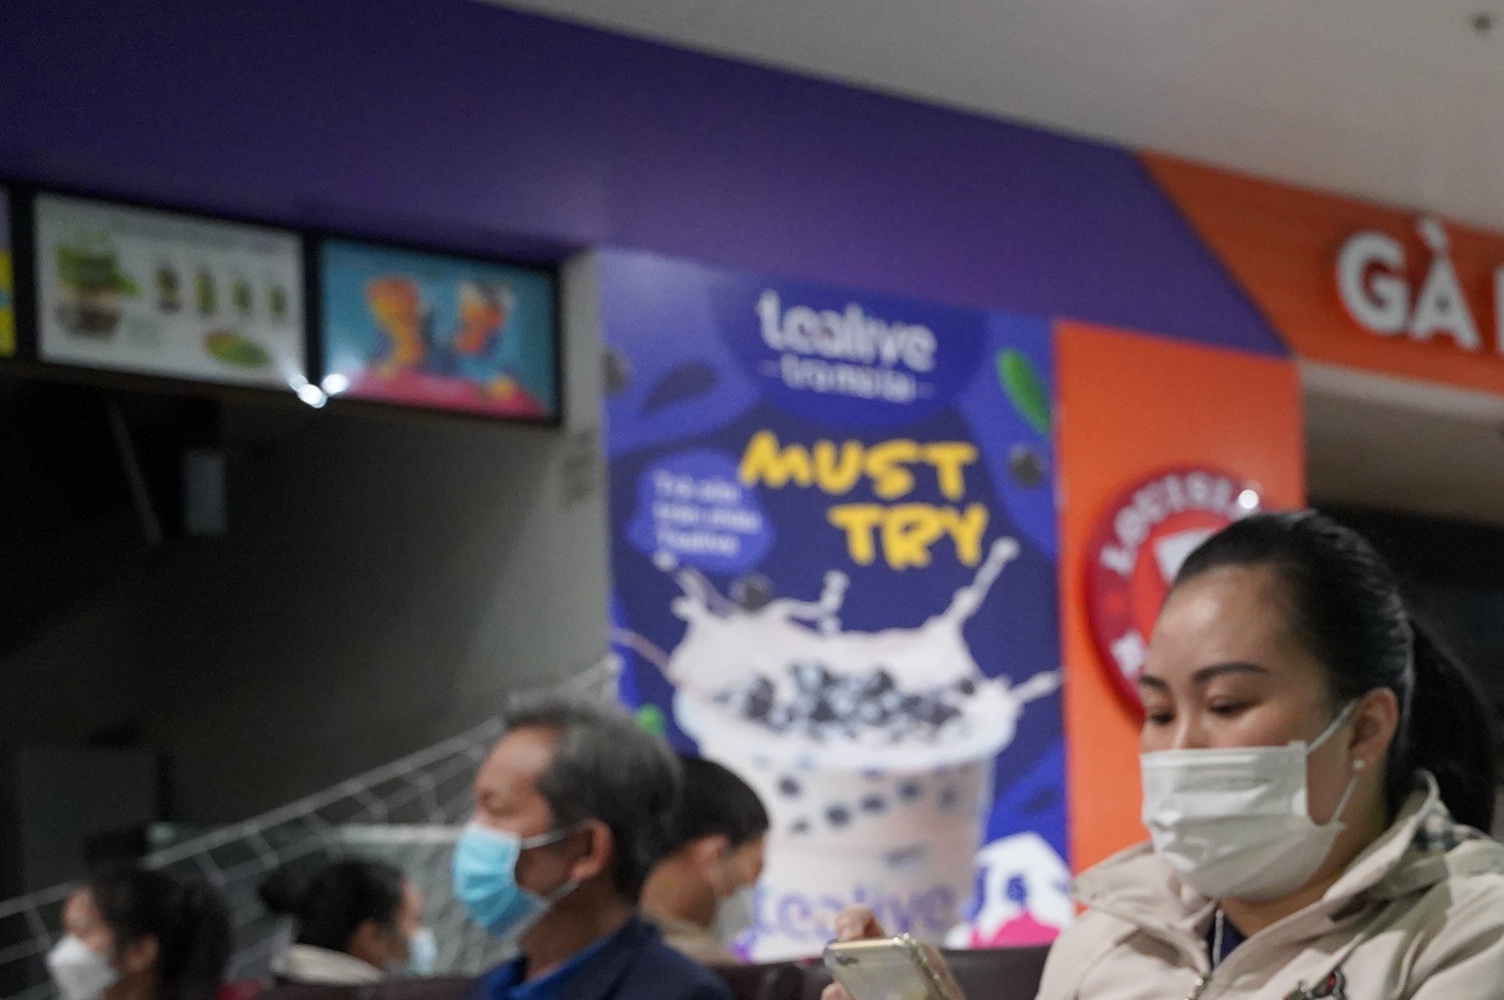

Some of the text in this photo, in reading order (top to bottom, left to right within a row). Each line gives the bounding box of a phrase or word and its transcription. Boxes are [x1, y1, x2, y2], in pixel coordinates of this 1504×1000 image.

[1336, 216, 1481, 352] GÀ
[739, 431, 978, 499] MUST
[828, 505, 988, 569] TRY
